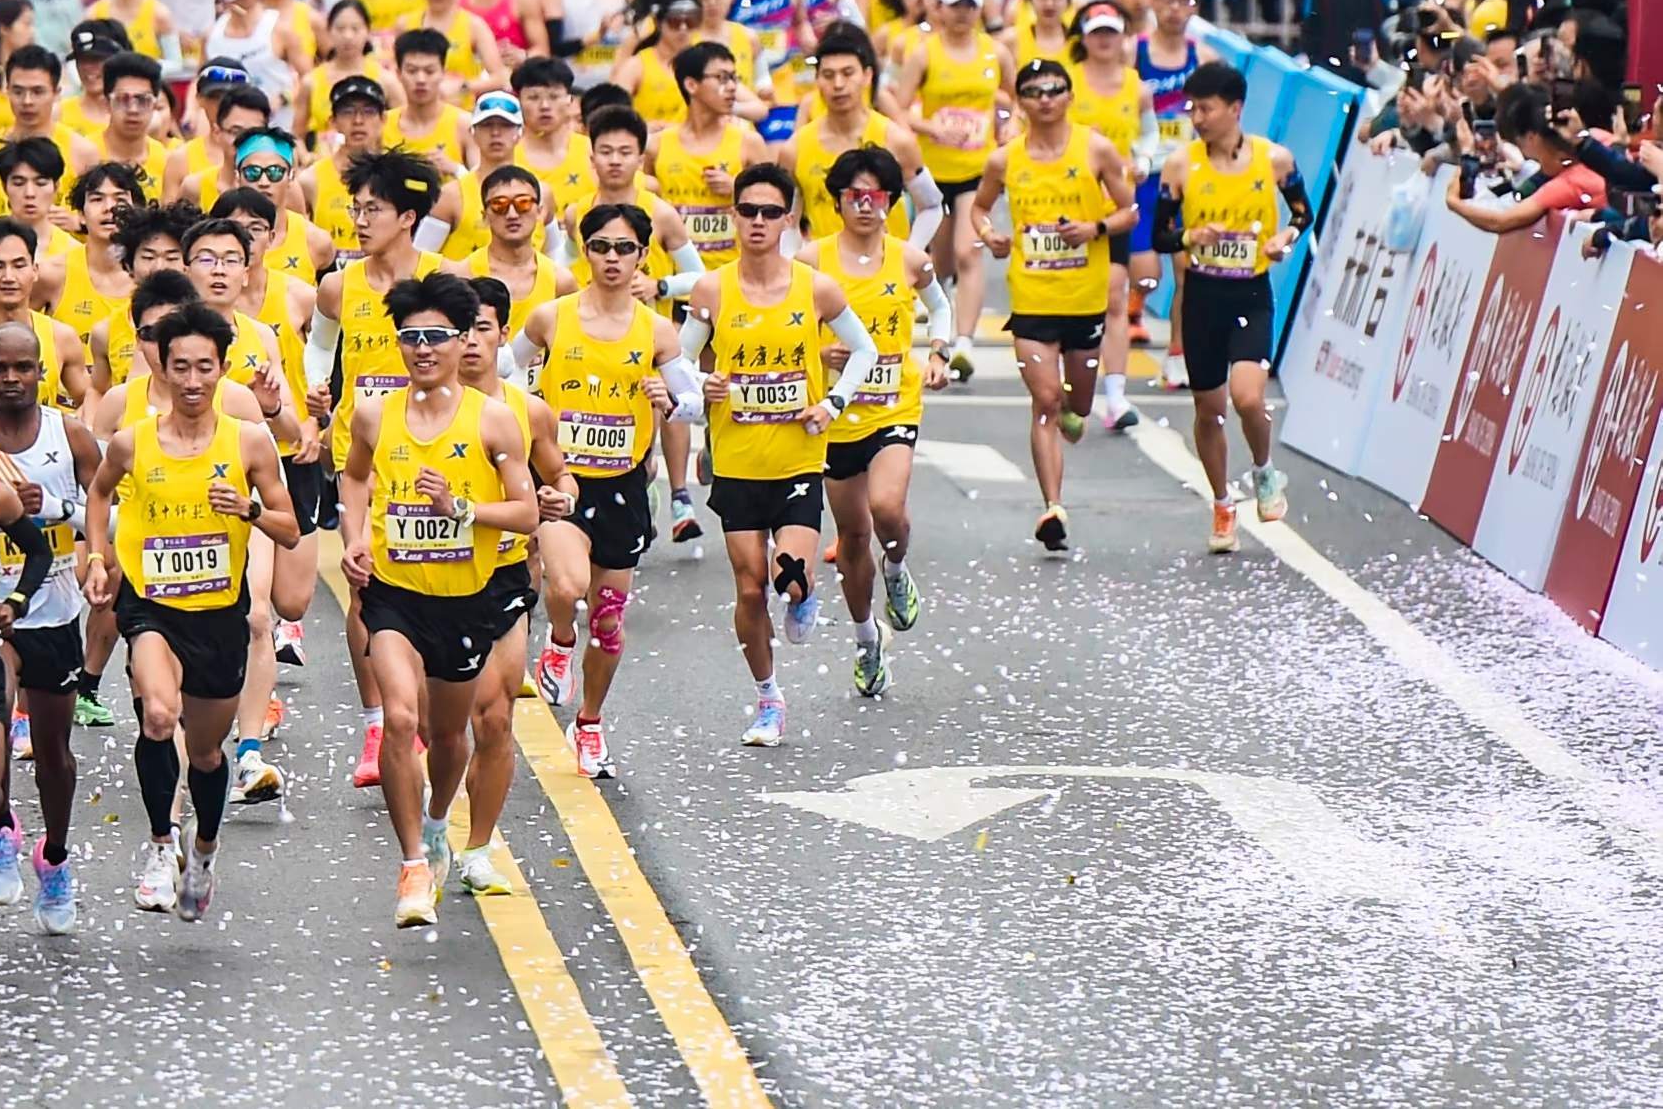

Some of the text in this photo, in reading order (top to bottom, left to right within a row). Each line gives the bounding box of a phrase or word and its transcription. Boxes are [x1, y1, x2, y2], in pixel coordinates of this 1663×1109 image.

[693, 216, 728, 233] 0028
[1213, 243, 1248, 259] 0025
[740, 384, 798, 404] Y 0032
[570, 425, 626, 448] Y 0009
[396, 518, 461, 540] Y 0027
[154, 548, 218, 573] Y 0019
